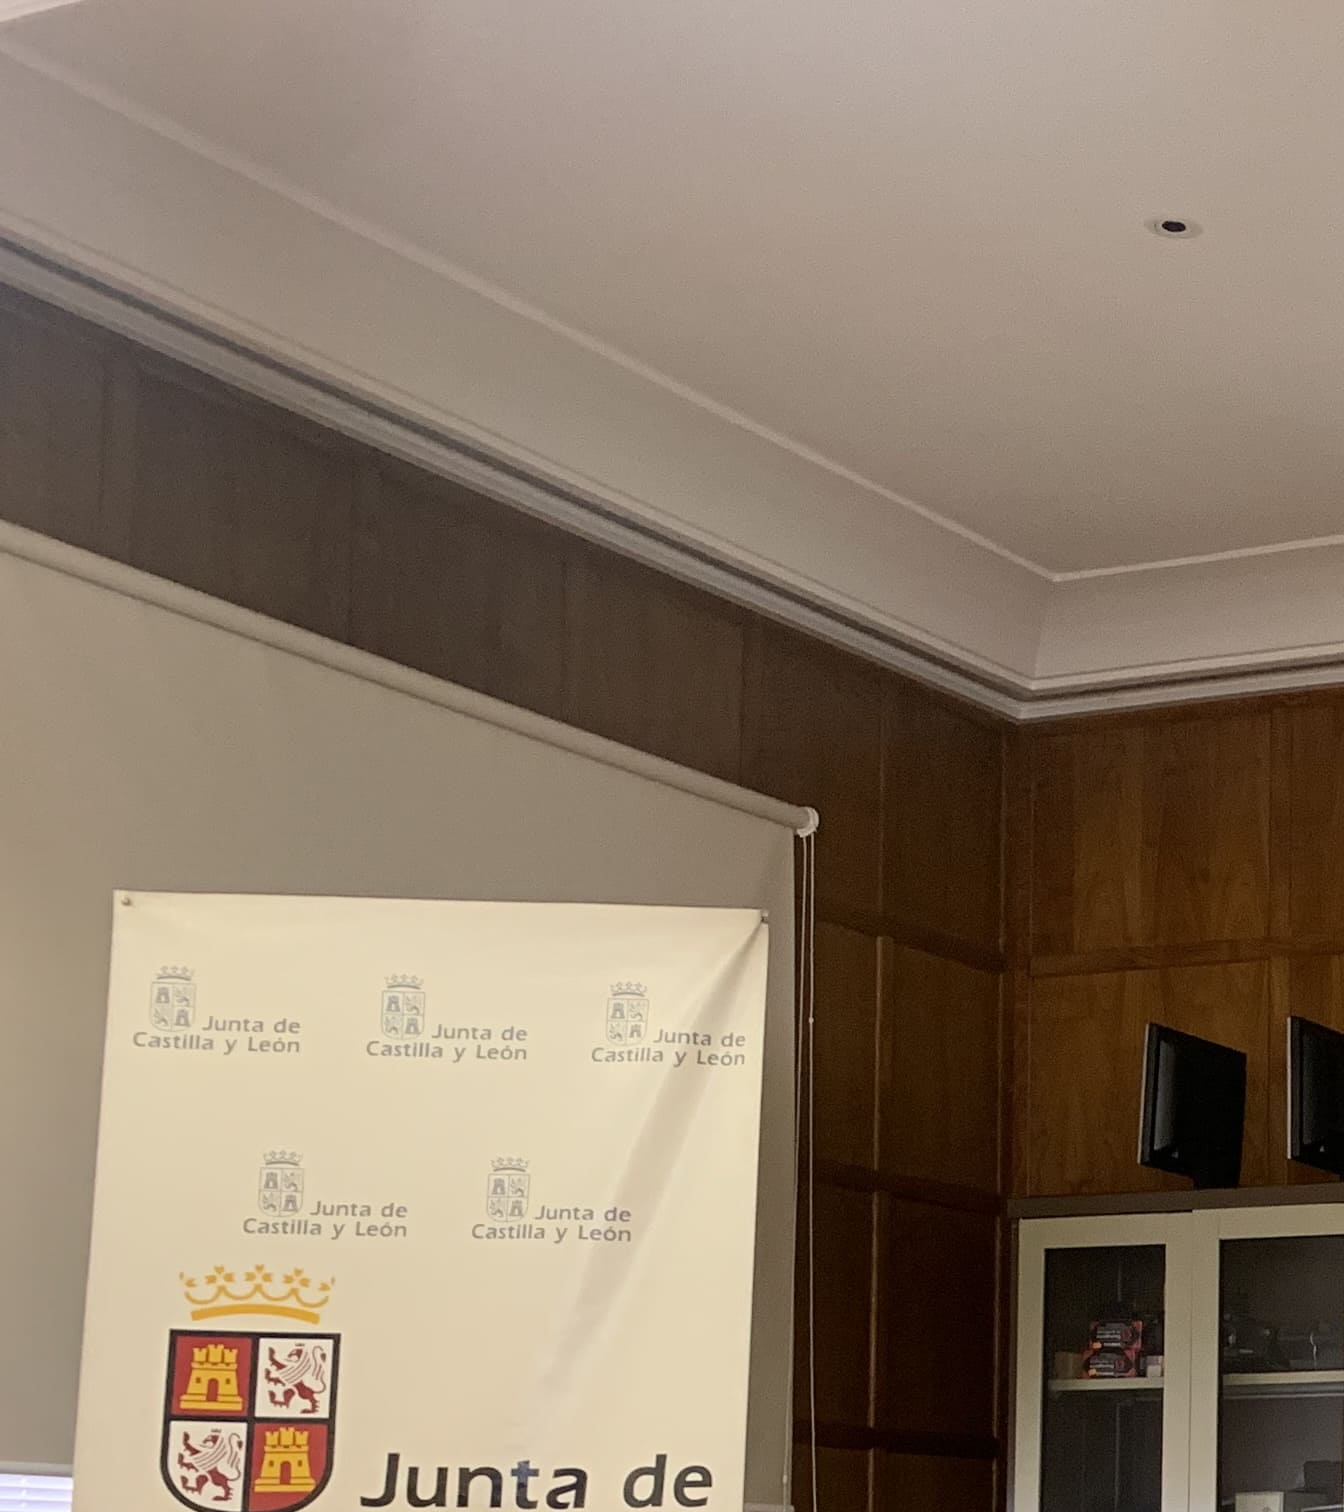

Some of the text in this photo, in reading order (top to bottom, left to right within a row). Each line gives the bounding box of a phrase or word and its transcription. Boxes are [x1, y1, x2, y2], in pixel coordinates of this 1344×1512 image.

[202, 1016, 300, 1034] Junta de
[432, 1024, 527, 1041] Junta de
[133, 1032, 299, 1055] Castilla y León
[654, 1029, 745, 1047] Junta de
[367, 1041, 527, 1063] Castilla y León
[592, 1048, 745, 1068] Castilla y León
[310, 1201, 407, 1218] Junta de
[535, 1206, 631, 1222] Junta de
[243, 1218, 406, 1240] Castilla y León
[472, 1224, 631, 1244] Castilla y León
[360, 1453, 712, 1509] Junta de
